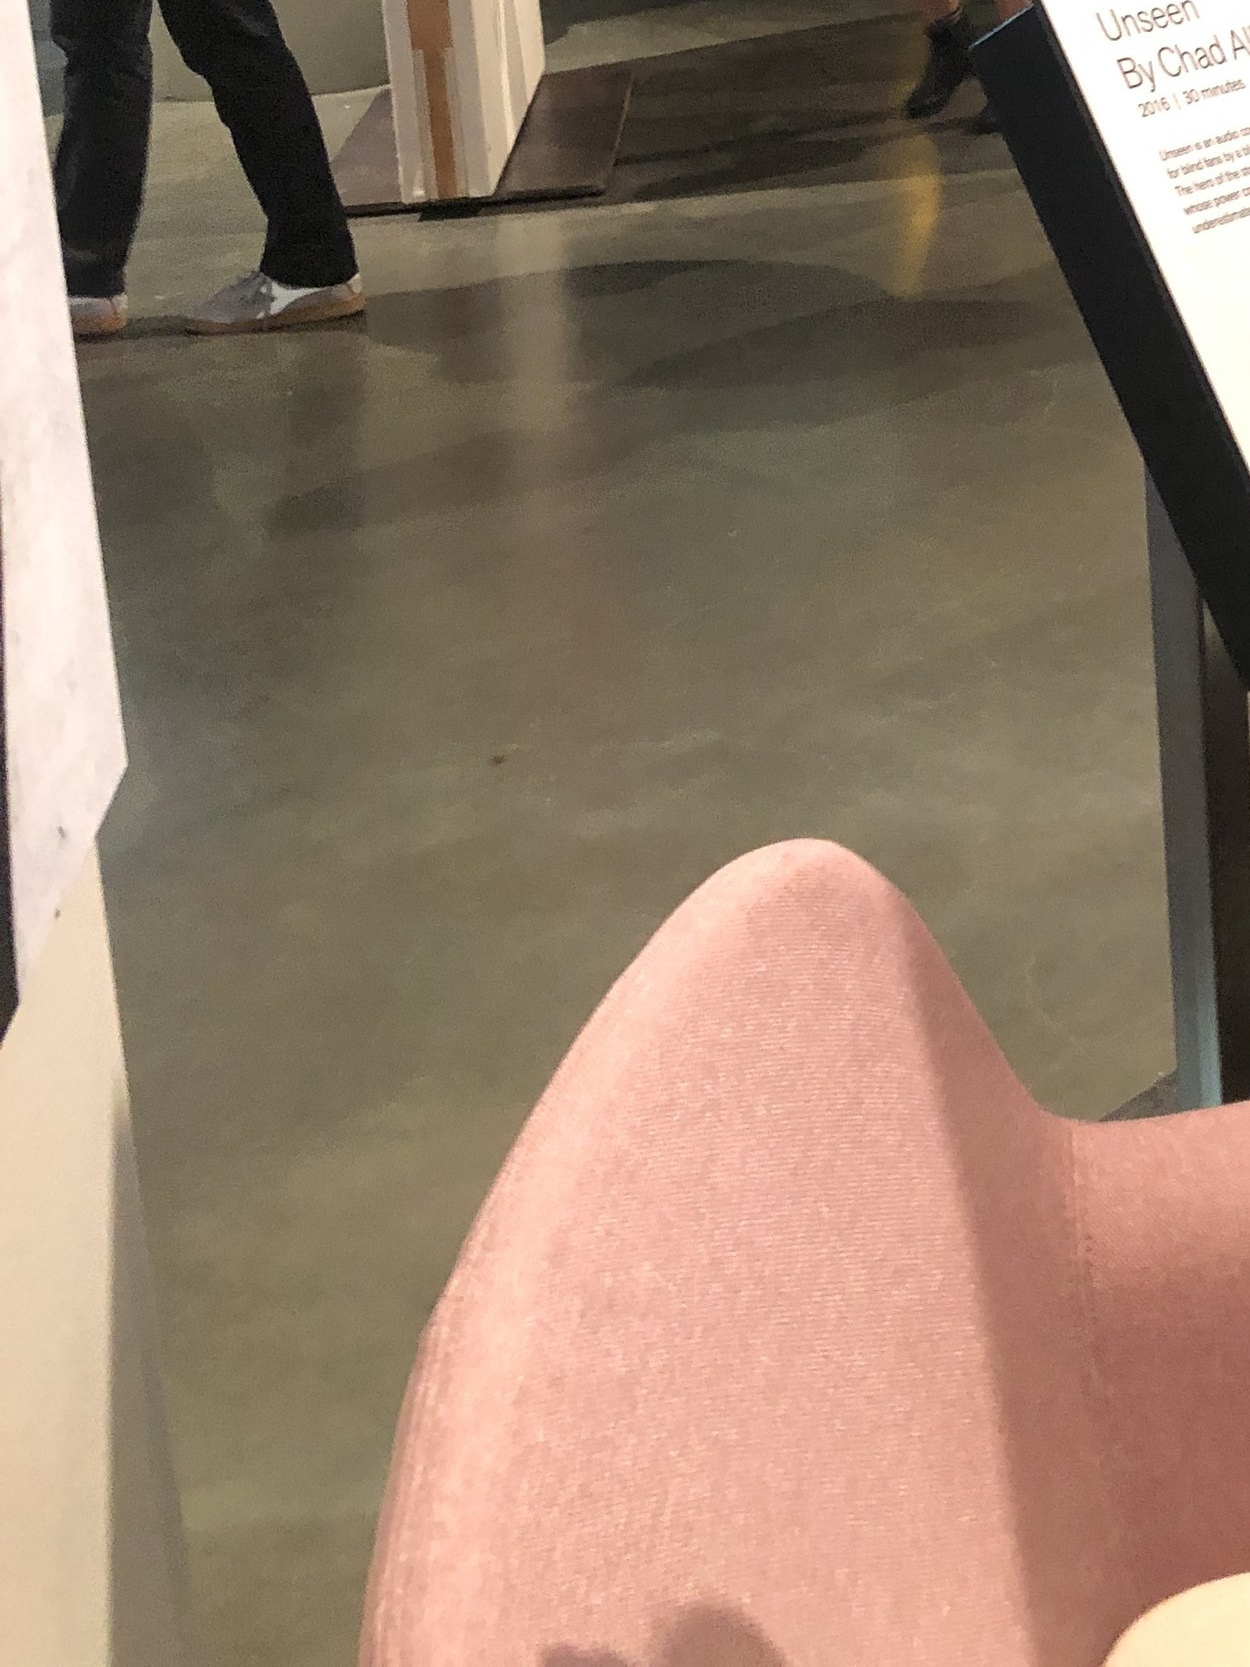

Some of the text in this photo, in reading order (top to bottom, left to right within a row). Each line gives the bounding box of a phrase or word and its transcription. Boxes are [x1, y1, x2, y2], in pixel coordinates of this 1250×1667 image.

[1096, 0, 1200, 41] Unseen
[1117, 56, 1156, 93] By
[1157, 34, 1226, 78] Chad
[1137, 96, 1171, 118] 2016
[1182, 88, 1200, 105] 30
[1201, 78, 1246, 99] minutes
